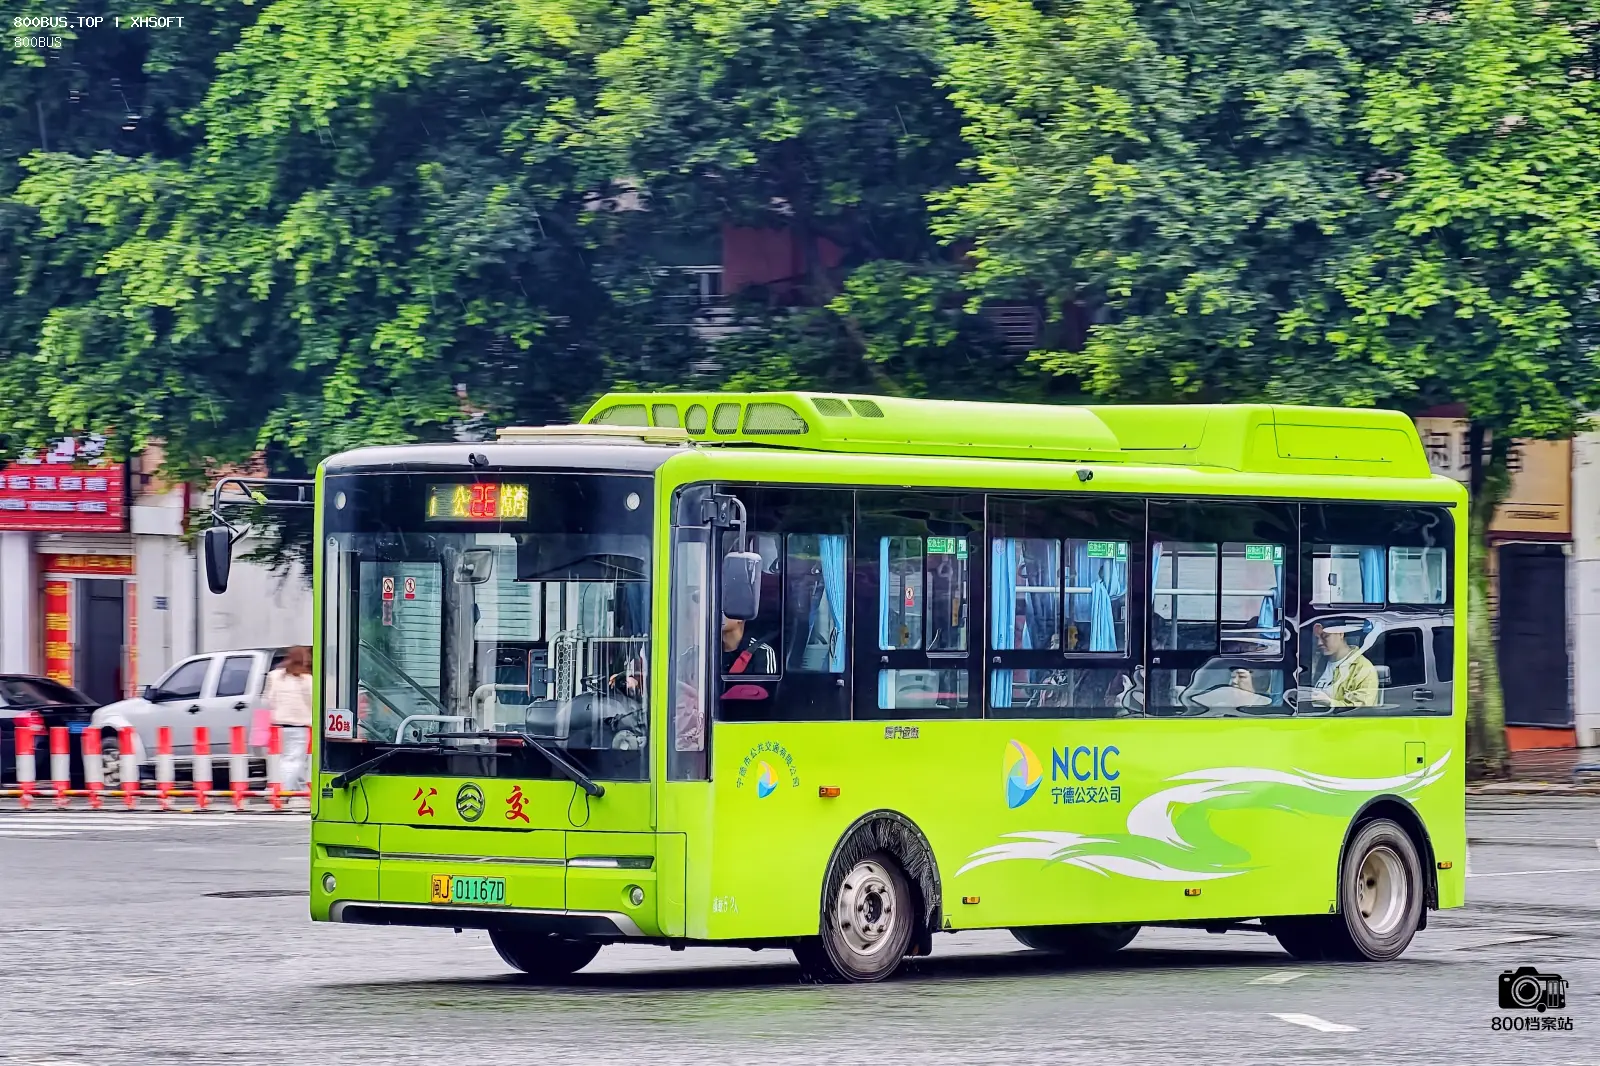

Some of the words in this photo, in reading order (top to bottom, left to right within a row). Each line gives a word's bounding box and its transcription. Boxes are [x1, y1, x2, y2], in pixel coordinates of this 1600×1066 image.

[1051, 745, 1120, 781] NCIC
[413, 787, 438, 817] 公
[505, 785, 530, 823] 交
[1051, 786, 1120, 804] 宁德公交公司
[455, 879, 504, 901] 01167D
